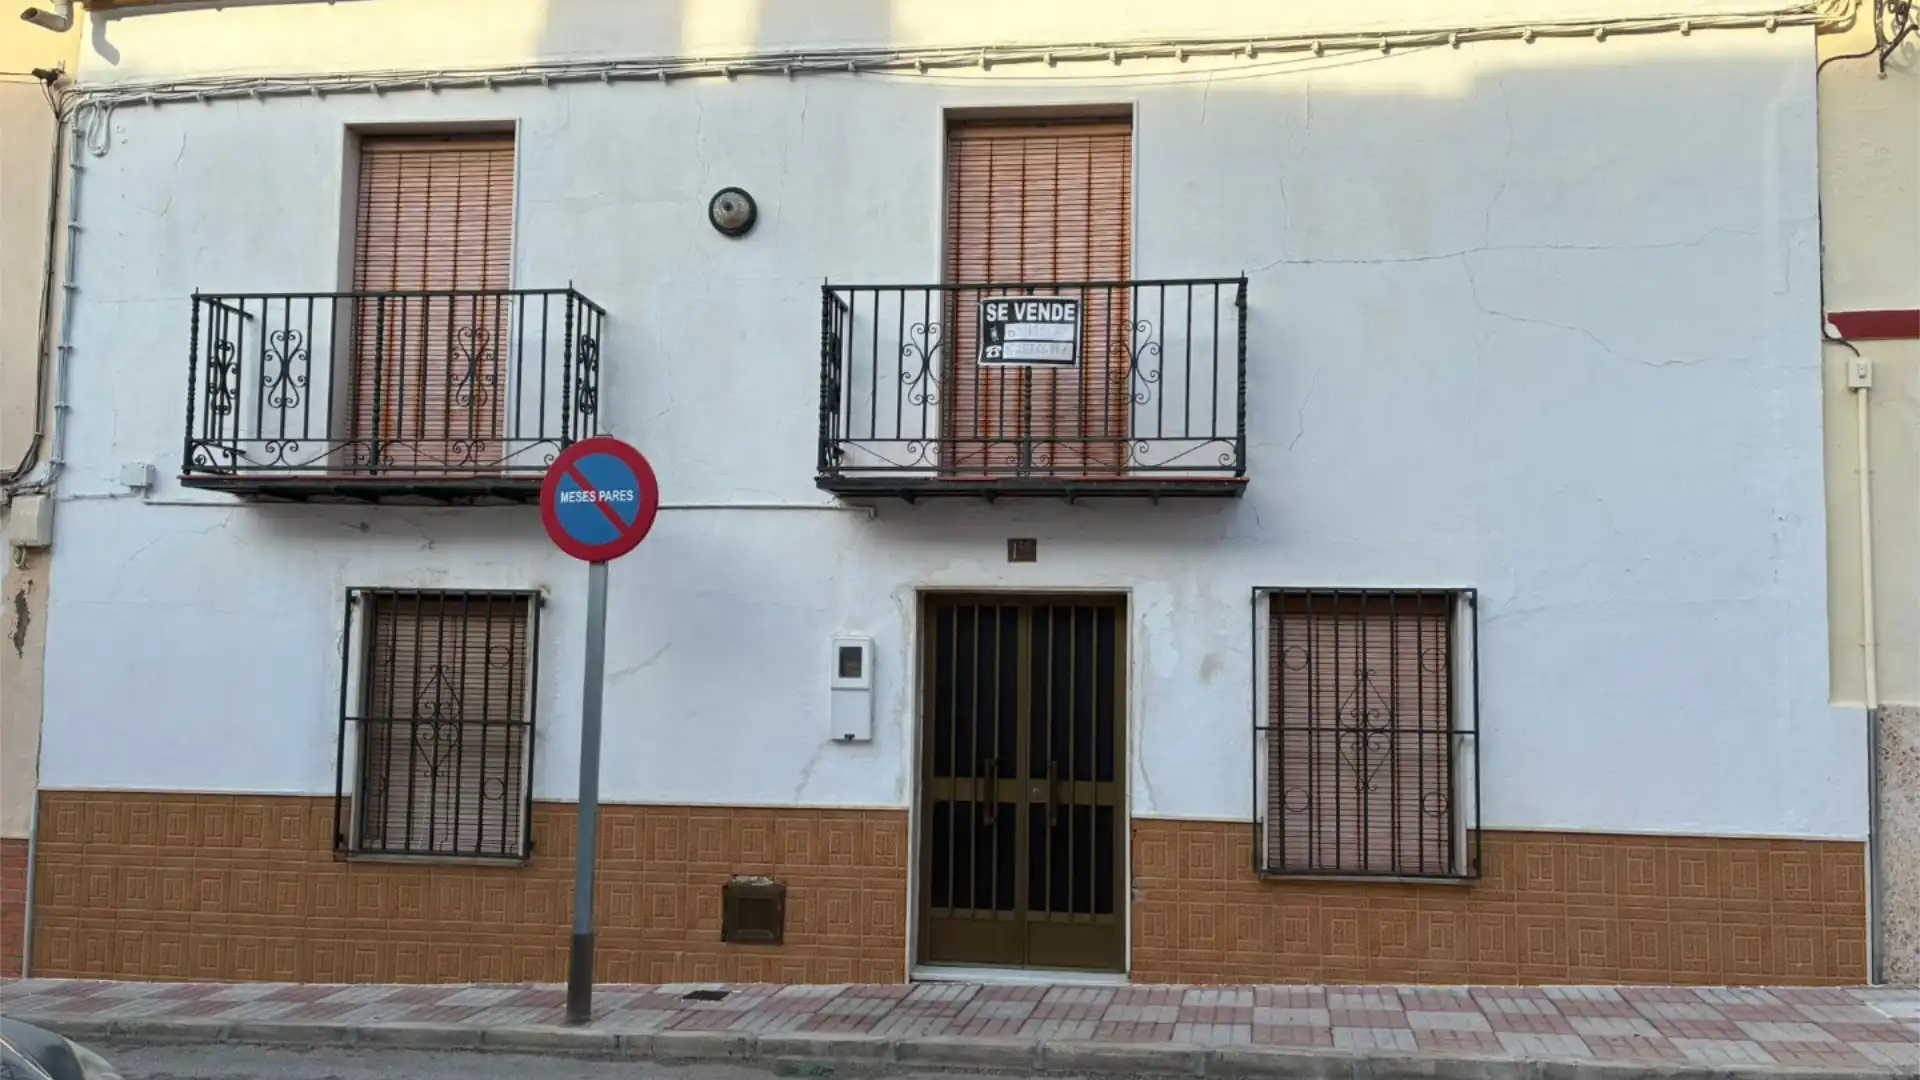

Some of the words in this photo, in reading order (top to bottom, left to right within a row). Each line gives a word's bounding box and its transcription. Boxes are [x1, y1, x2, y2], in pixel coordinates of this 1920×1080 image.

[986, 302, 1009, 322] SE
[1013, 302, 1076, 321] VENDE
[560, 490, 596, 503] MESES
[598, 489, 634, 502] PARES
